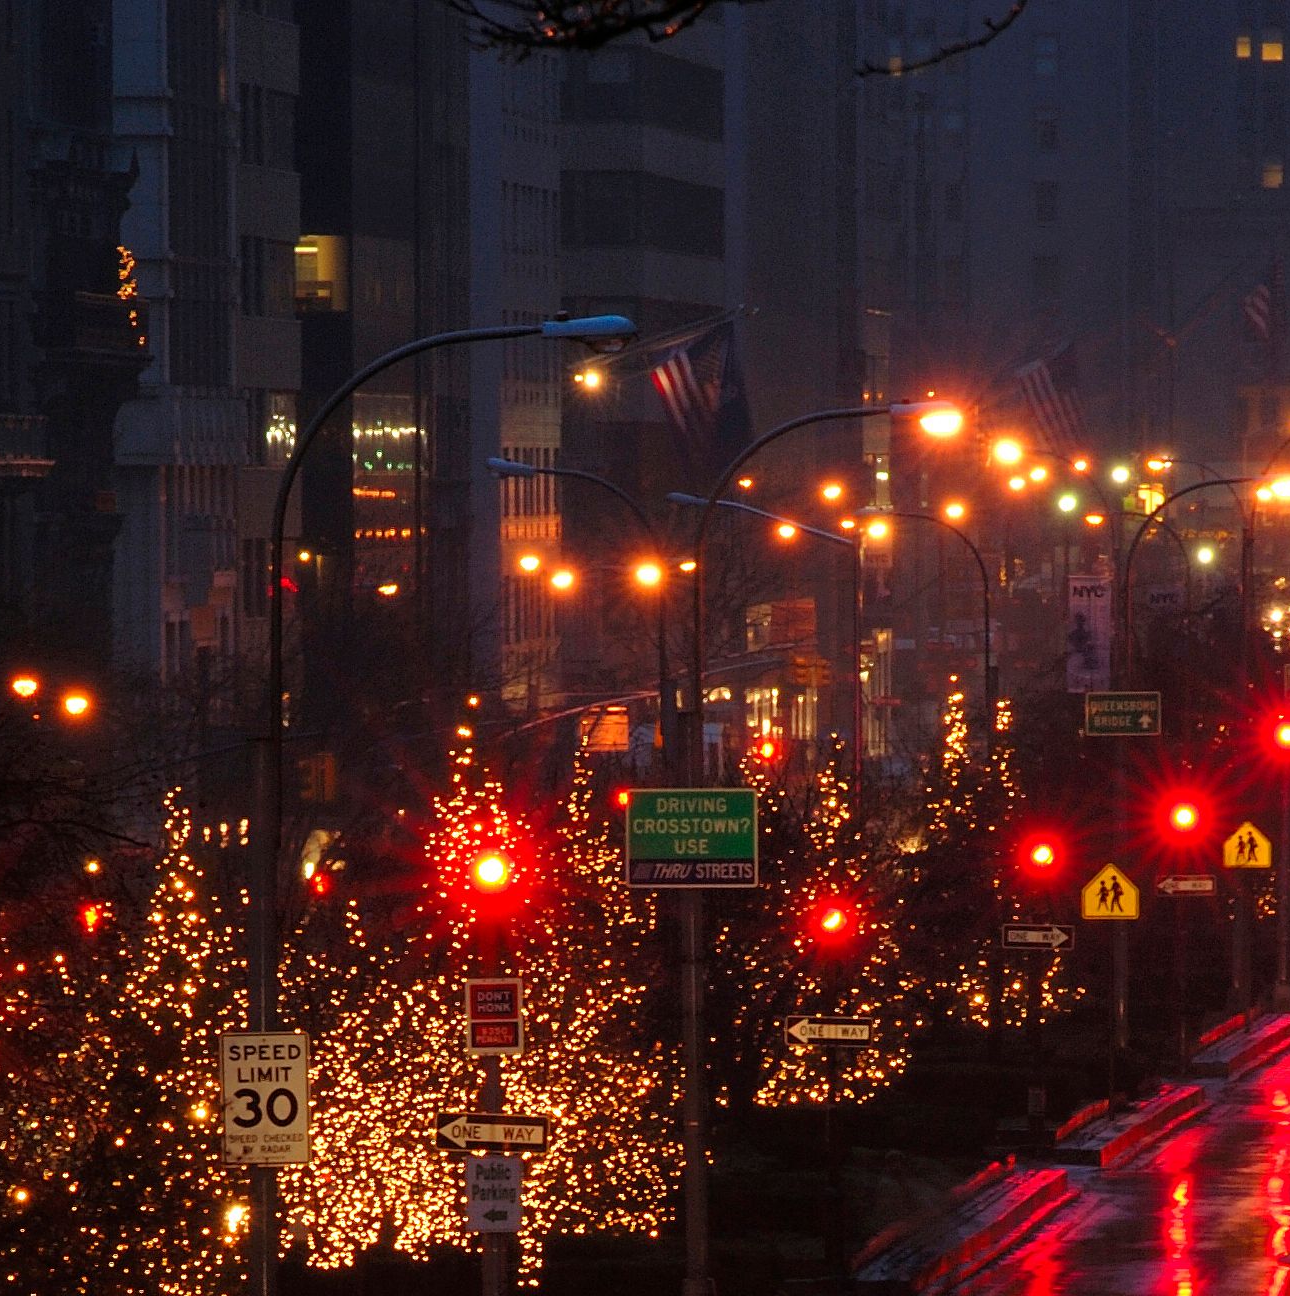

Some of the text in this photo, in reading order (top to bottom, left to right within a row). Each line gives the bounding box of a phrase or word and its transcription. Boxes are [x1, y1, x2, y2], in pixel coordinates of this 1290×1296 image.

[1072, 585, 1105, 598] NYC
[1090, 700, 1157, 711] QUEENSBORO
[1094, 715, 1132, 726] BRIDGE
[656, 797, 727, 813] DRIVING
[633, 818, 751, 834] CROSSTOWN?
[674, 839, 709, 854] USE
[653, 863, 754, 878] THRU STREETS
[477, 1003, 511, 1013] HONK
[799, 1025, 866, 1038] ONE WAY
[229, 1044, 301, 1060] SPEED
[237, 1066, 292, 1083] LIMIT
[232, 1088, 299, 1128] 30
[229, 1134, 304, 1144] SPEED CHECKED
[451, 1124, 535, 1141] ONE WAY
[243, 1144, 291, 1154] BY RADAR
[476, 1162, 511, 1180] Public
[471, 1184, 516, 1204] Parking
